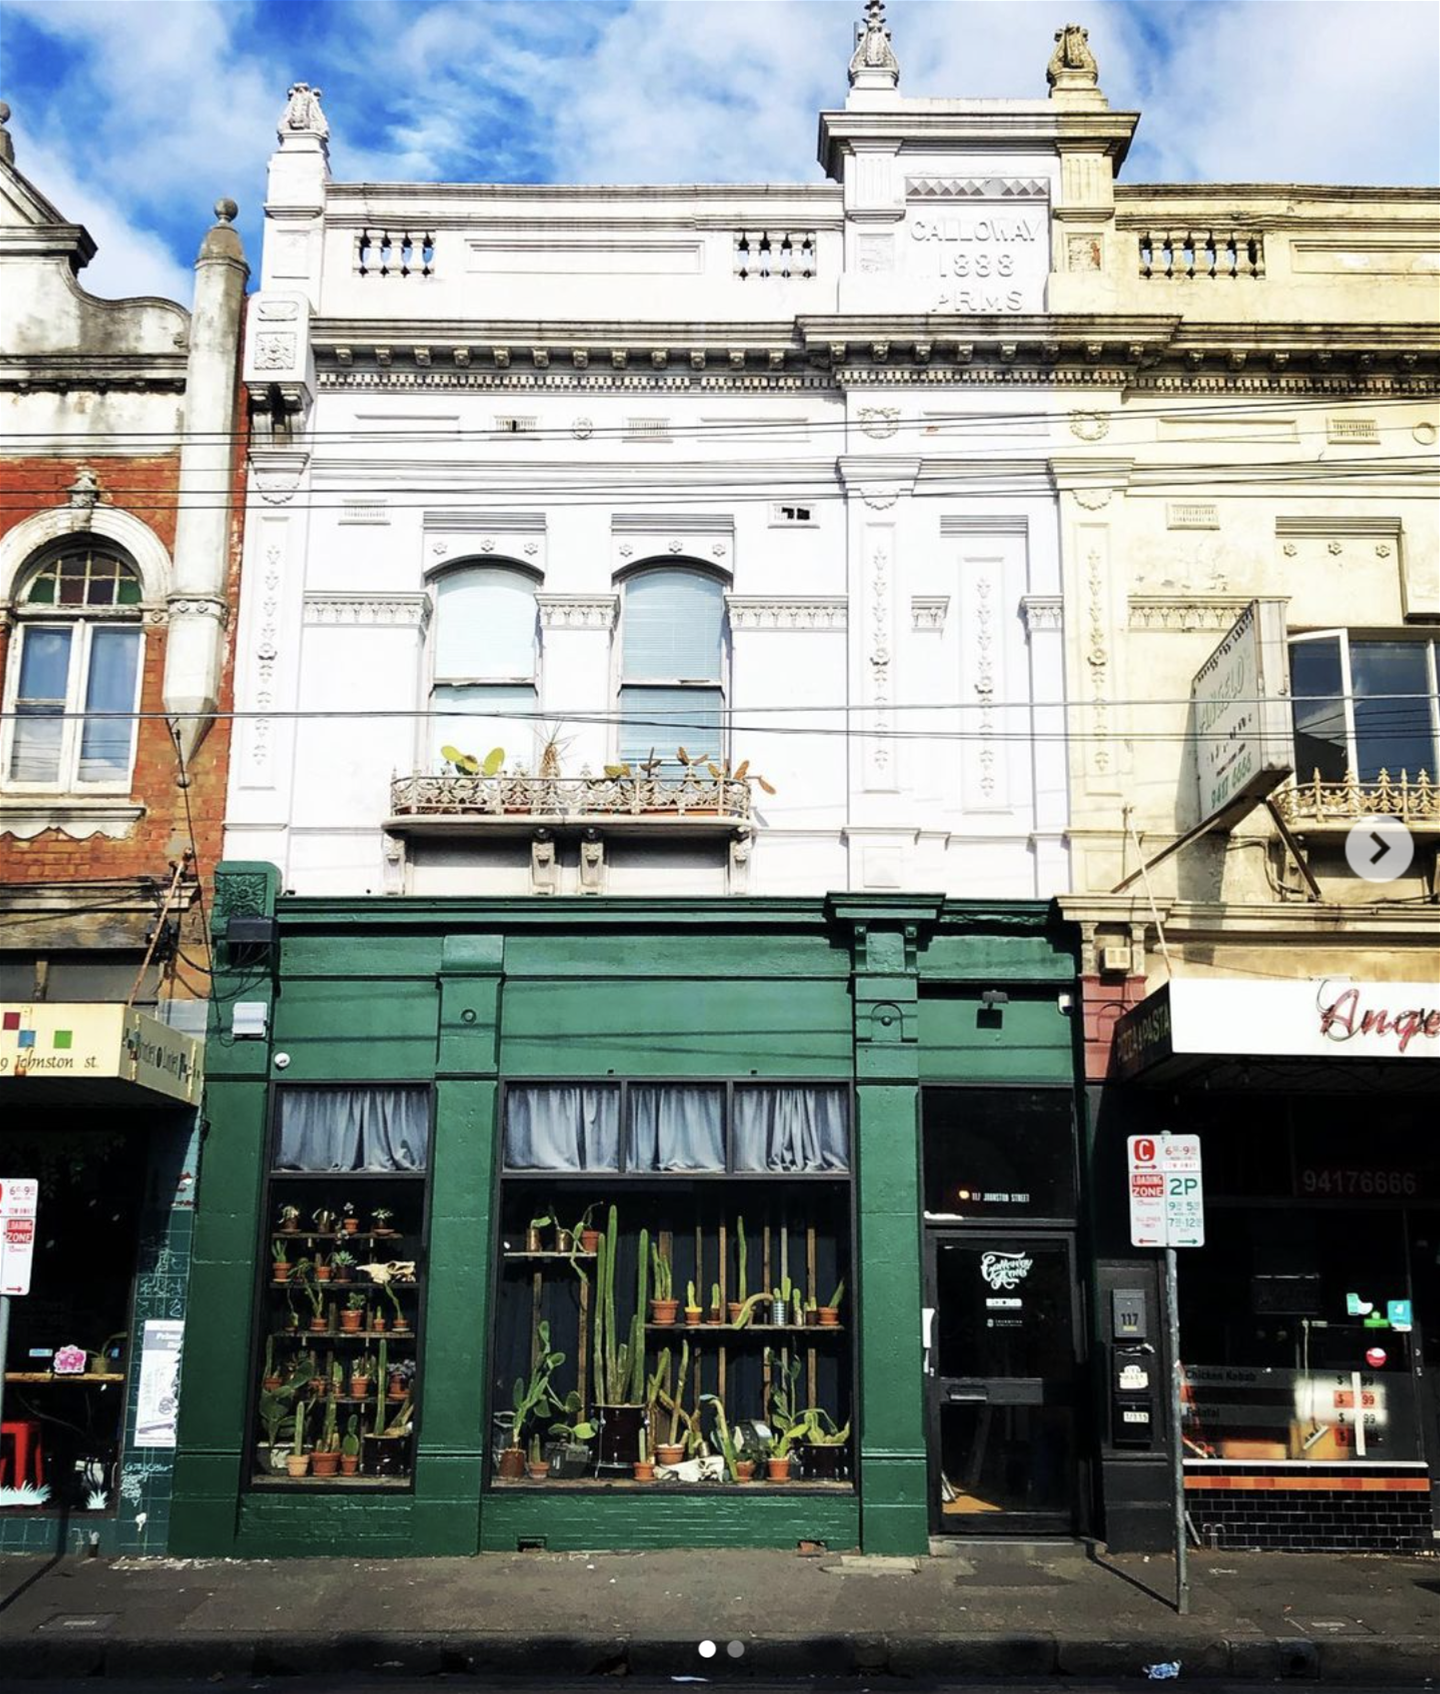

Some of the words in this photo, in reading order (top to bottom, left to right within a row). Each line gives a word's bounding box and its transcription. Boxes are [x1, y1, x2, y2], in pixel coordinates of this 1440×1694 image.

[910, 218, 1041, 242] CALLOWAY
[939, 254, 1015, 278] 1888
[931, 290, 1025, 312] ARMS
[1142, 1001, 1171, 1048] PASTA
[1133, 1186, 1164, 1197] ZONE
[1169, 1178, 1198, 1196] 2P
[1302, 1169, 1417, 1195] 94176666
[6, 1232, 32, 1243] ZONE
[1120, 1313, 1139, 1327] 117
